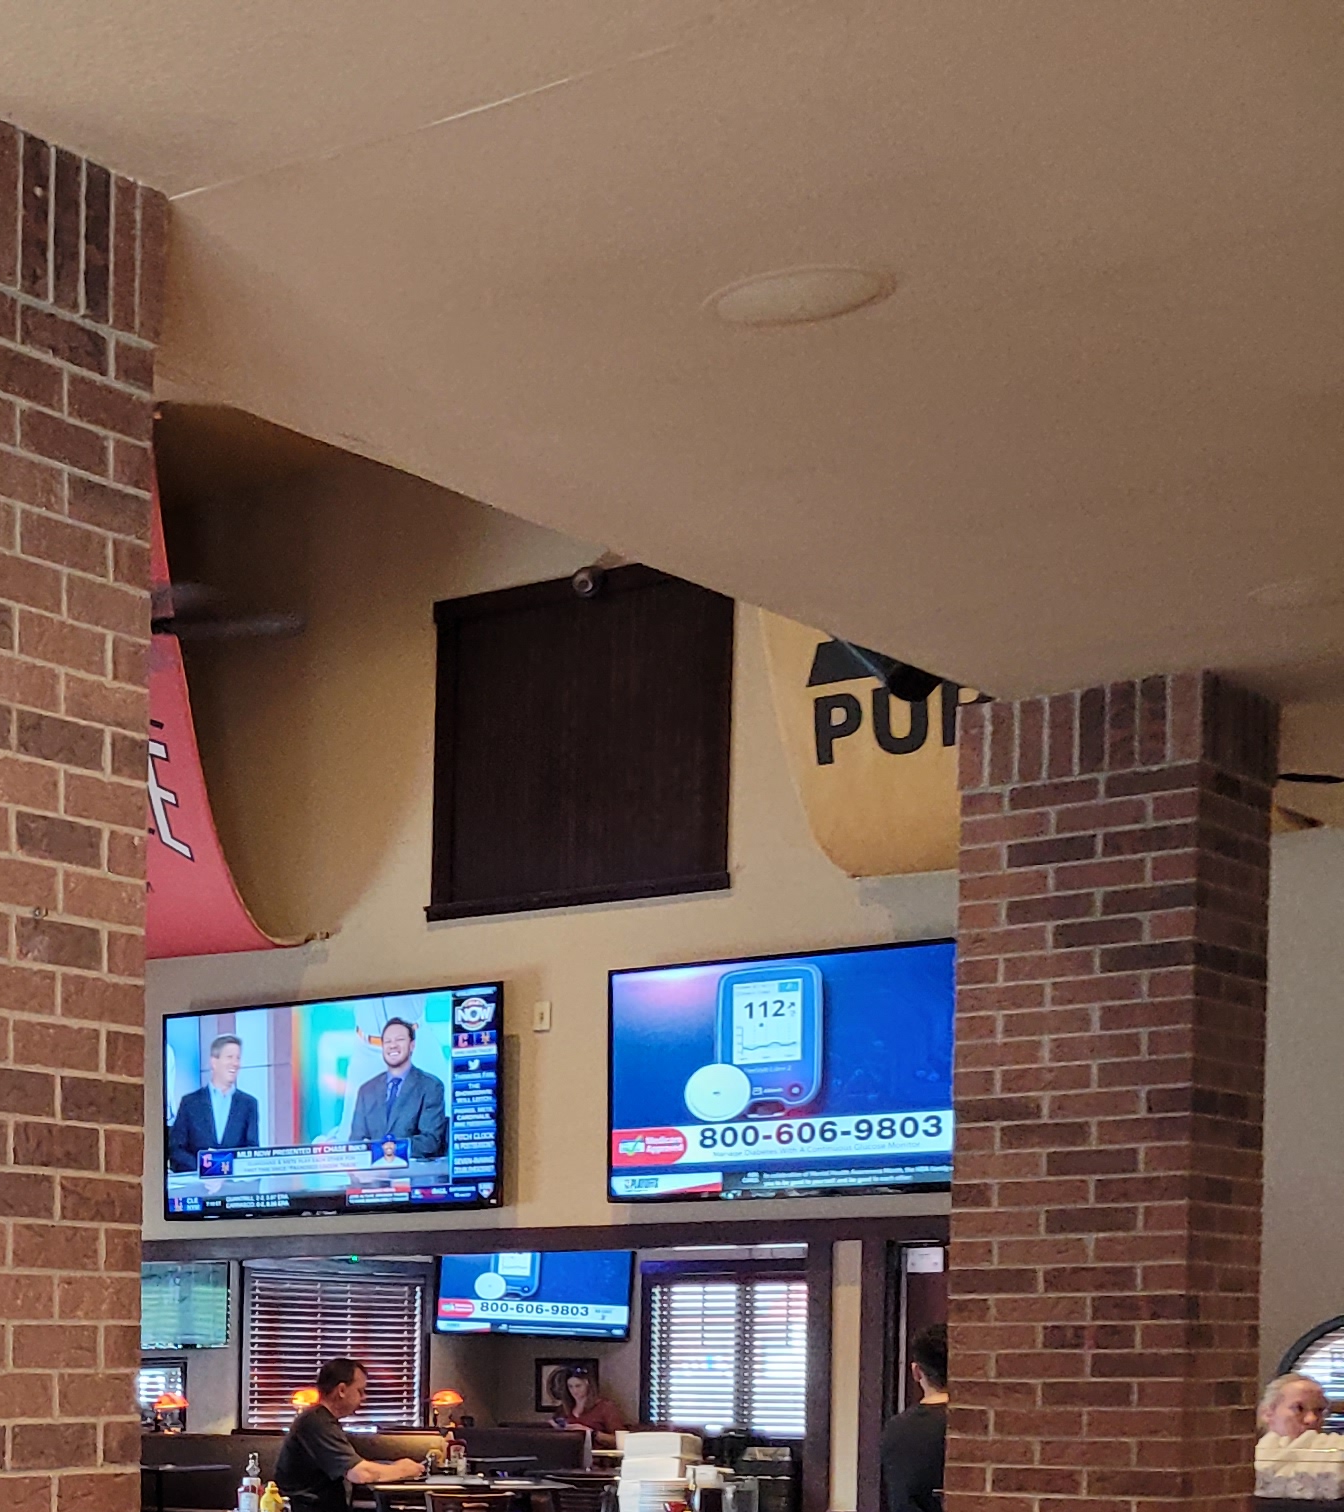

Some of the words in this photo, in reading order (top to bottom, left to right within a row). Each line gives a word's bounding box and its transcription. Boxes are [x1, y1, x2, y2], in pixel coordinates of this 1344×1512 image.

[457, 1006, 493, 1021] NOW
[744, 999, 786, 1019] 112
[699, 1114, 944, 1149] 800-606-9803
[480, 1301, 589, 1317] 800-606-9803
